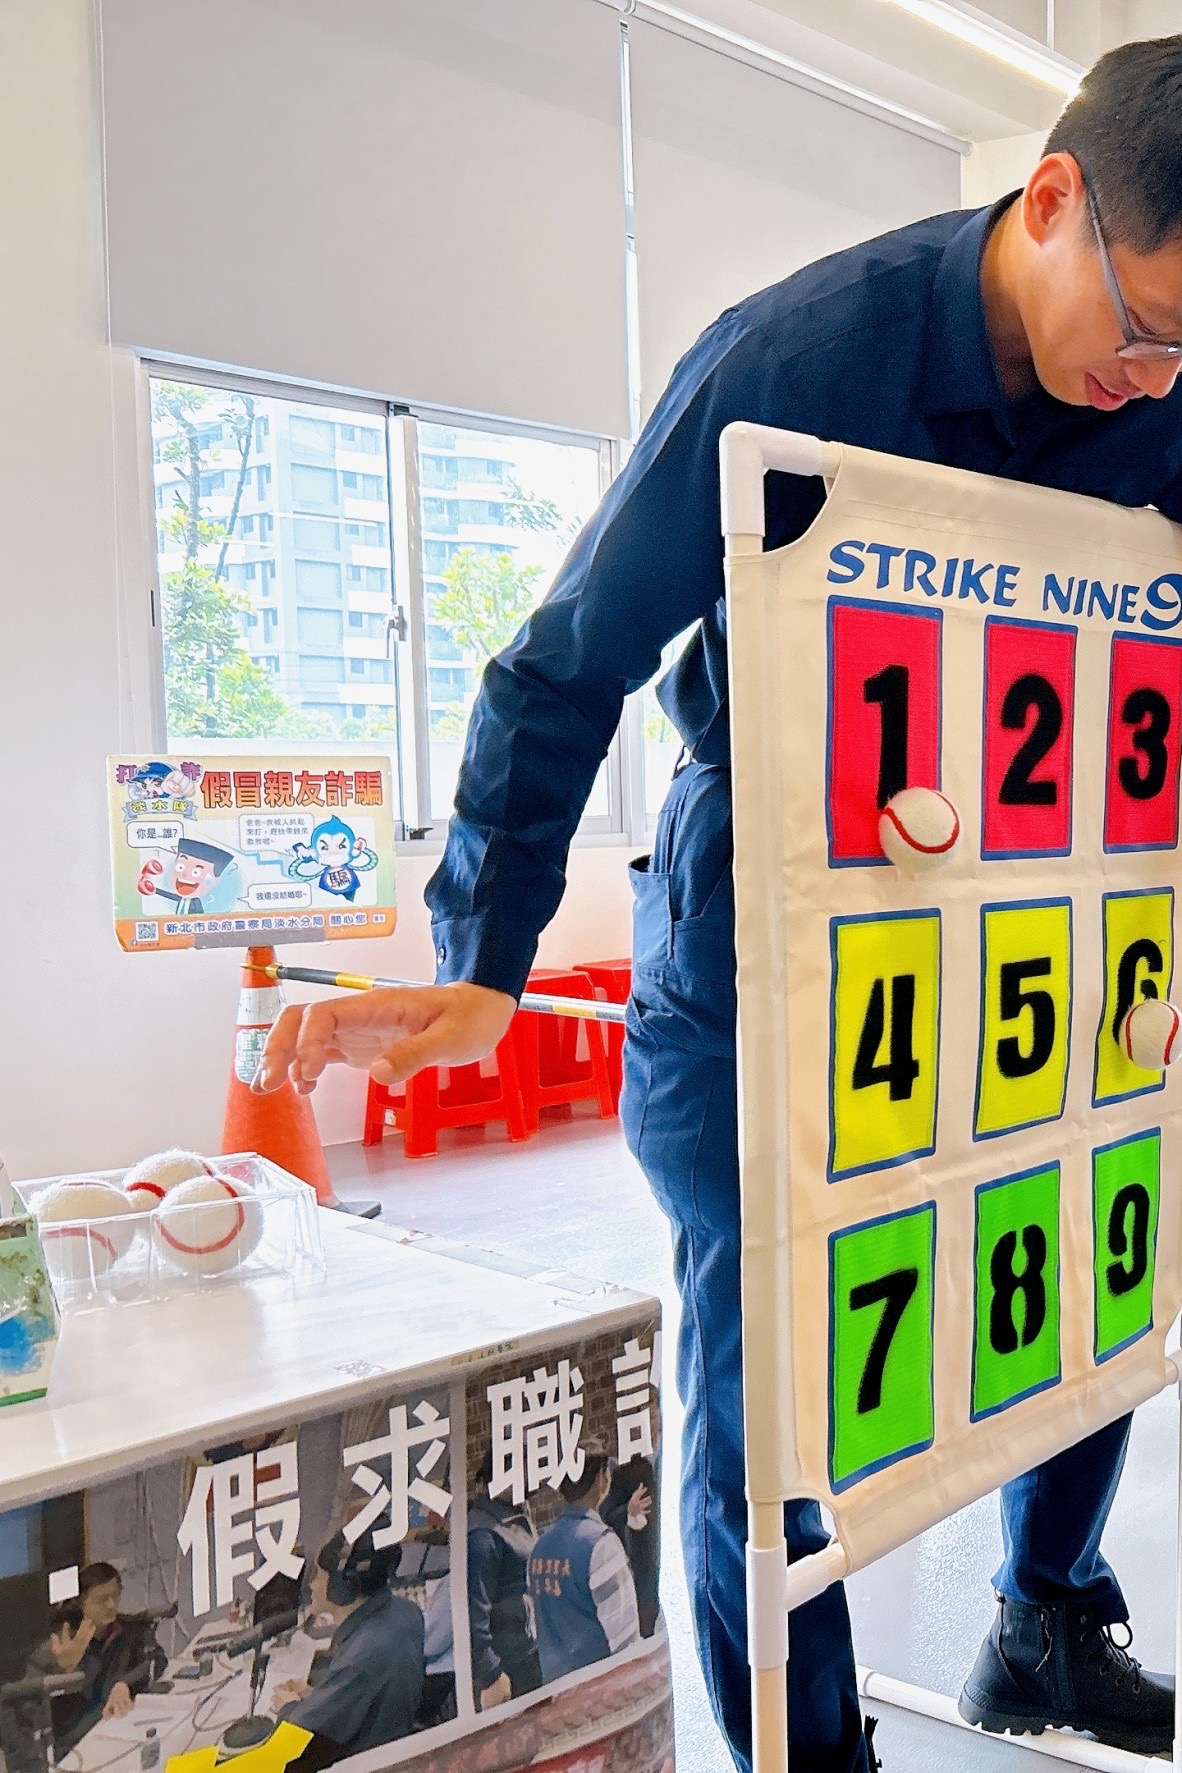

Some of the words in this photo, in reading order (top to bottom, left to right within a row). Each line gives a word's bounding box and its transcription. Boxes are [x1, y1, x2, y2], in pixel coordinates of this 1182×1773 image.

[827, 541, 1019, 608] STRIKE
[200, 770, 384, 809] 假冒親友詐騙
[863, 665, 909, 810] 1
[999, 674, 1062, 805] 2
[1118, 688, 1171, 800] 3
[166, 915, 324, 933] 新北市政府警察局淡水分局
[330, 912, 366, 925] 關心您
[852, 975, 919, 1101] 4
[996, 957, 1055, 1079] 5
[1113, 939, 1162, 1044] 6
[850, 1268, 918, 1415] 7
[989, 1224, 1047, 1355] 8
[1107, 1183, 1150, 1297] 9
